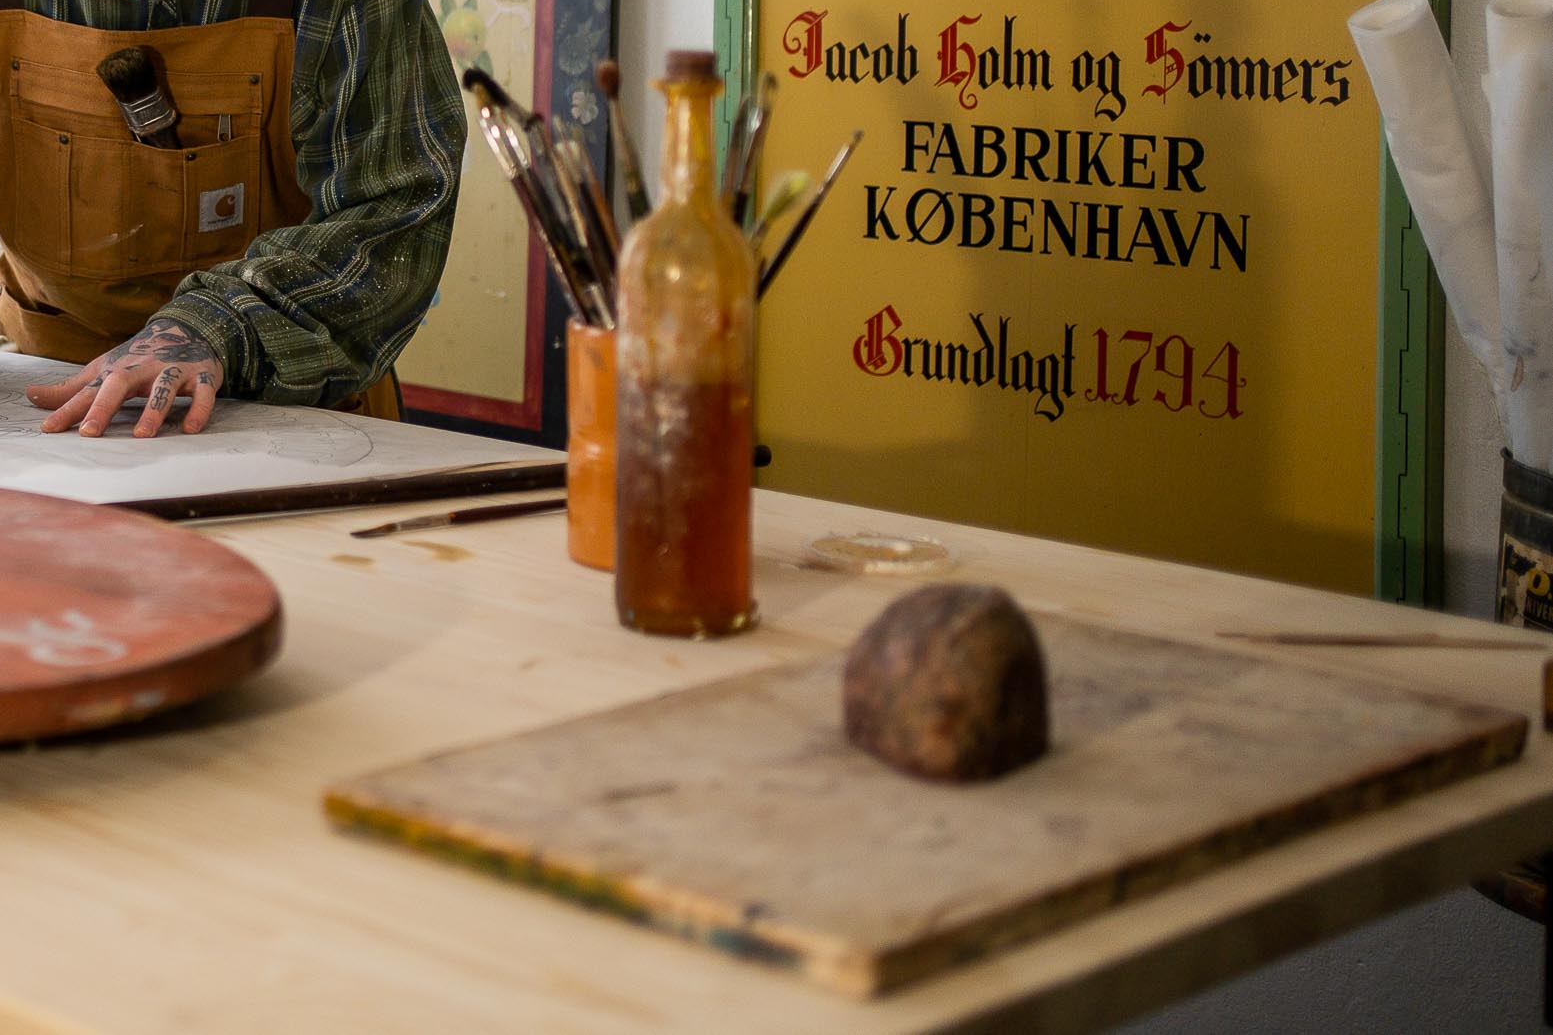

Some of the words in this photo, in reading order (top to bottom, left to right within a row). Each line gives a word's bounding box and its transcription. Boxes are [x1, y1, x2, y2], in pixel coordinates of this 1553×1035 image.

[782, 7, 919, 86] Jacob
[934, 13, 1054, 111] Holm
[1070, 49, 1128, 122] og
[1141, 20, 1354, 107] Sönners
[901, 120, 1207, 193] FABRIKER
[862, 185, 1251, 273] KØBENHAVN
[852, 304, 1079, 423] Grundlagt
[1084, 328, 1248, 420] 1794
